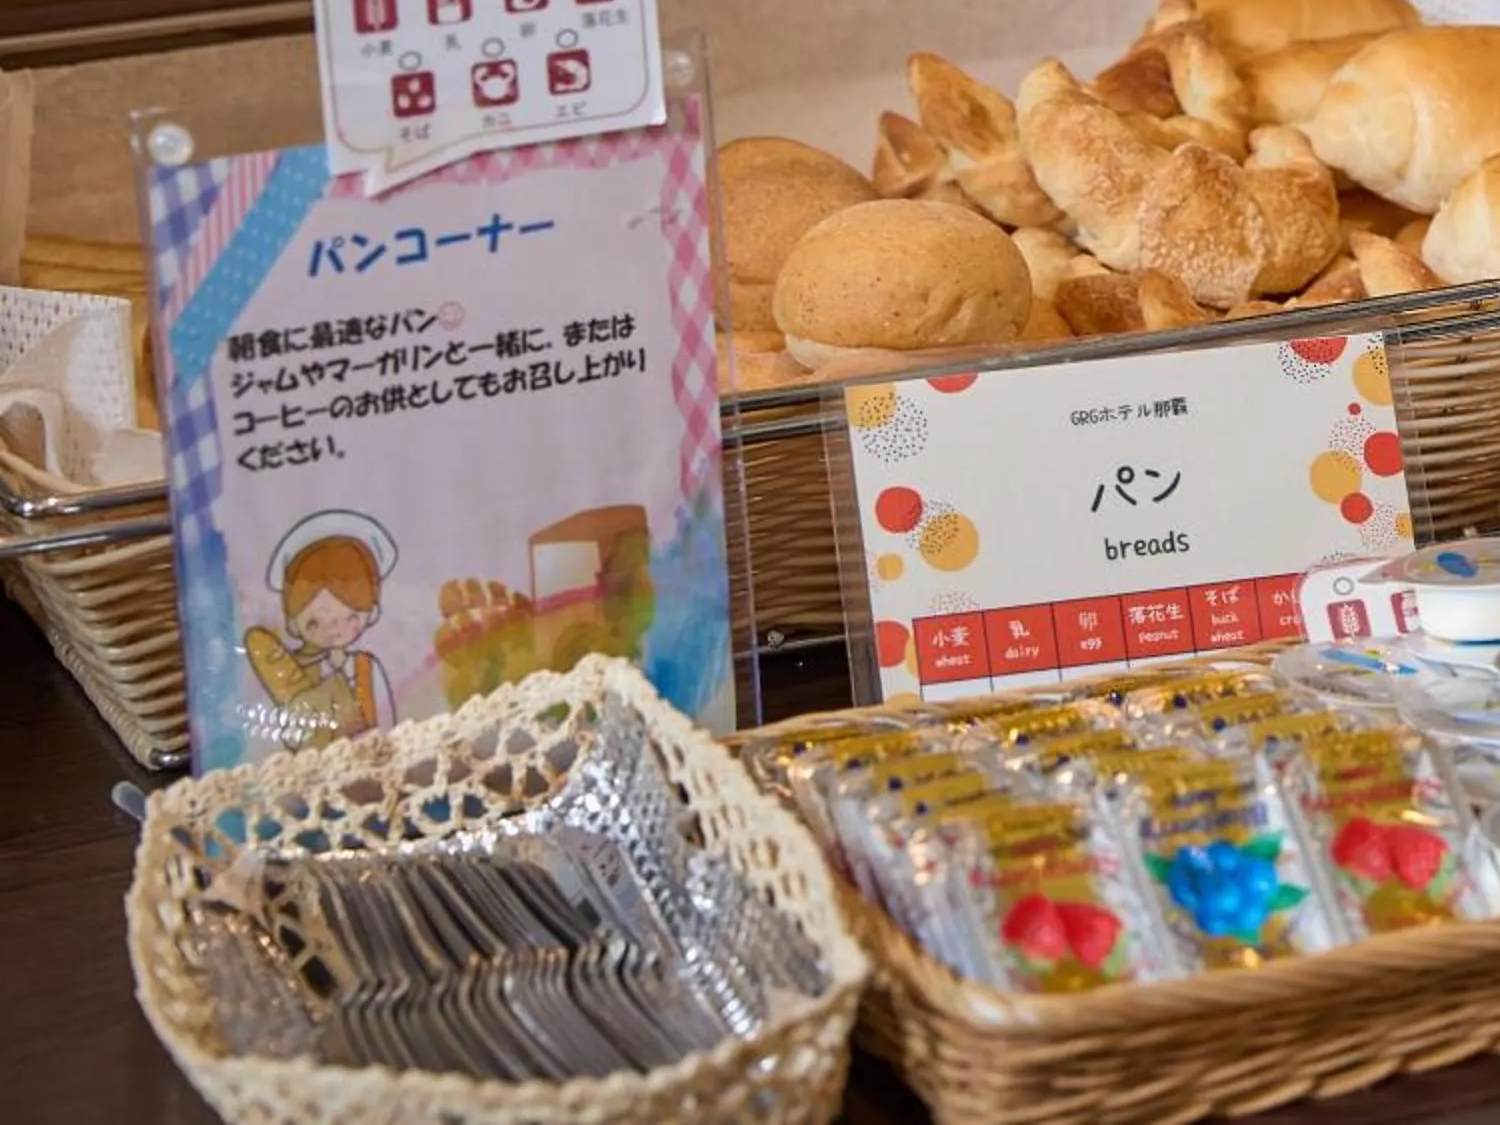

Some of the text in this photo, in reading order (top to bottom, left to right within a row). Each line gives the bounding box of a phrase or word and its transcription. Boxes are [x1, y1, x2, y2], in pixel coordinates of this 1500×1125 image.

[307, 213, 555, 277] パンコーナー
[228, 308, 438, 363] 朝食に最適なパン
[233, 347, 646, 436] コーヒーのお供としてもお召し上がり
[236, 435, 345, 473] ください。
[1090, 464, 1182, 513] パン
[1104, 530, 1191, 562] breads
[1204, 584, 1241, 607] そば
[1078, 610, 1099, 632] 卵
[1127, 602, 1185, 625] 落花生
[932, 626, 971, 649] 小麦
[1008, 618, 1032, 640] 乳
[1004, 645, 1040, 660] dairy
[1080, 637, 1102, 651] egg
[935, 653, 973, 668] wheat
